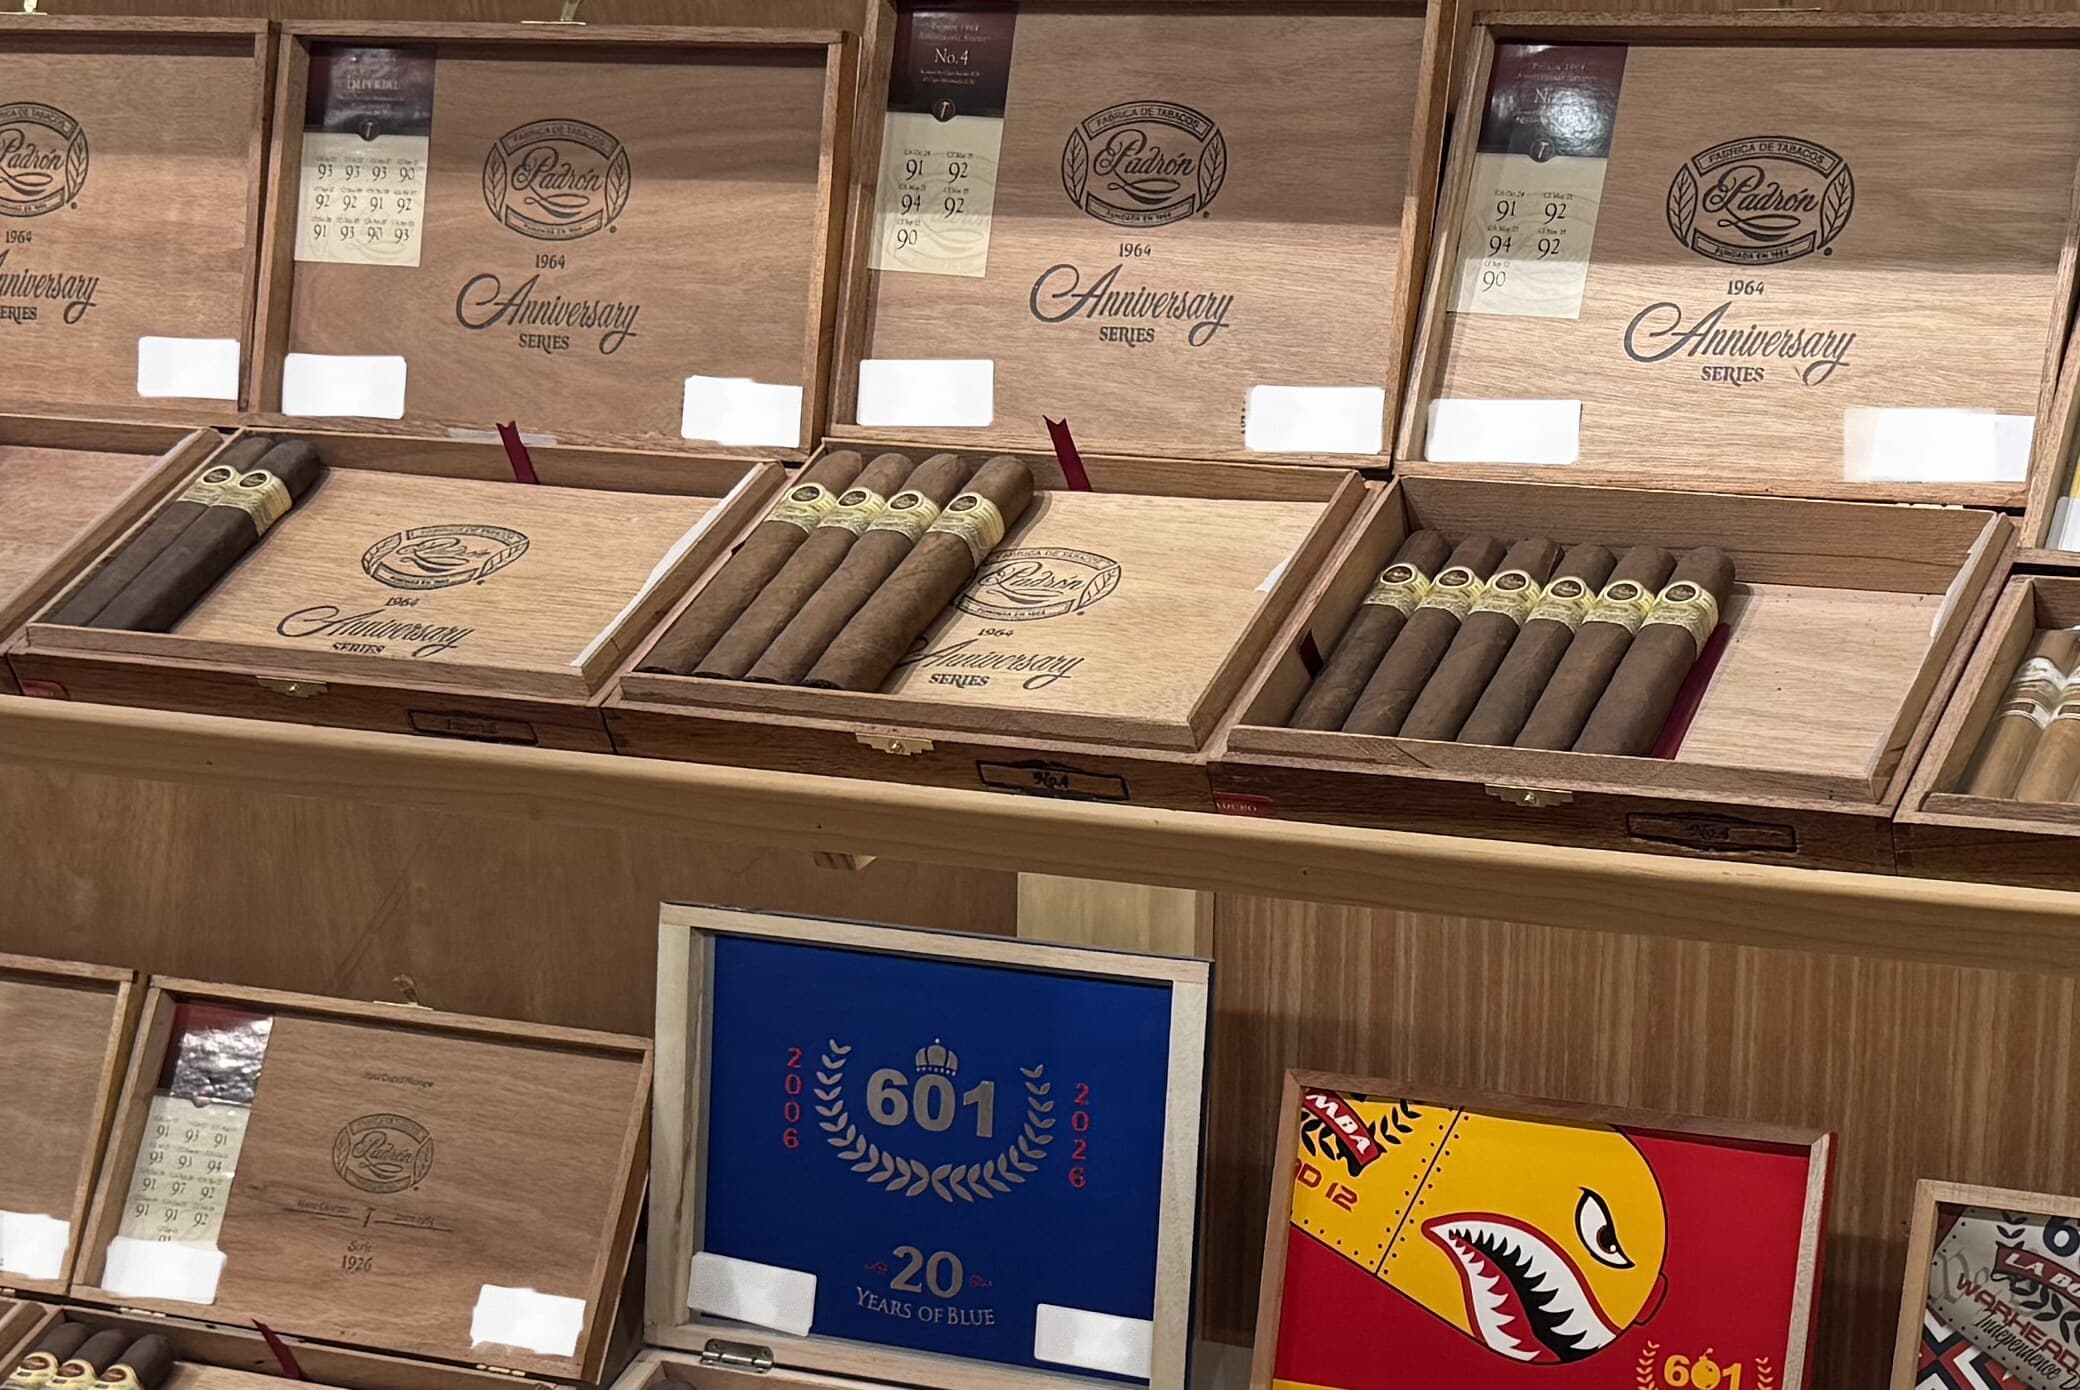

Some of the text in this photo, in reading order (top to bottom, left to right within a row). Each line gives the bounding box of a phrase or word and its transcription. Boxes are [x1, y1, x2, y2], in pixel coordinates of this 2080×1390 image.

[318, 163, 415, 182] 93 93 93 90
[905, 158, 968, 184] 91 92
[1093, 128, 1196, 206] Padrón
[511, 145, 605, 219] Padrón
[315, 193, 412, 213] 92 92 91 92
[900, 193, 964, 219] 94 92
[1496, 200, 1567, 225] 91 92
[1703, 164, 1819, 242] Padrón
[313, 223, 327, 240] 91
[340, 224, 355, 241] 93
[394, 227, 409, 244] 93
[896, 228, 918, 250] 90
[1119, 242, 1152, 258] 1964
[1488, 235, 1561, 261] 94 92
[535, 253, 566, 270] 1964
[1481, 270, 1506, 292] 90
[1727, 279, 1765, 296] 1964
[456, 273, 641, 355] Anniversary
[1029, 263, 1234, 347] Anniversary
[518, 333, 570, 354] SERIES
[1098, 326, 1156, 348] SERIES
[1623, 300, 1857, 387] Anniversary
[1700, 365, 1766, 387] SERIES
[928, 673, 990, 689] SERIES
[783, 1047, 803, 1149] 2006
[866, 1067, 995, 1138] 601
[156, 1123, 170, 1140] 91
[185, 1129, 200, 1145] 93
[214, 1132, 228, 1148] 91
[1068, 1082, 1090, 1189] 2026
[150, 1150, 164, 1166] 93
[178, 1154, 193, 1170] 93
[143, 1176, 157, 1192] 91
[135, 1203, 150, 1219] 91
[164, 1208, 178, 1223] 91
[341, 1254, 373, 1272] 1926
[889, 1245, 965, 1299] 20
[2004, 1252, 2044, 1277] LA
[856, 1285, 996, 1326] YEARS OF BLUE
[1973, 1308, 2062, 1380] Independence
